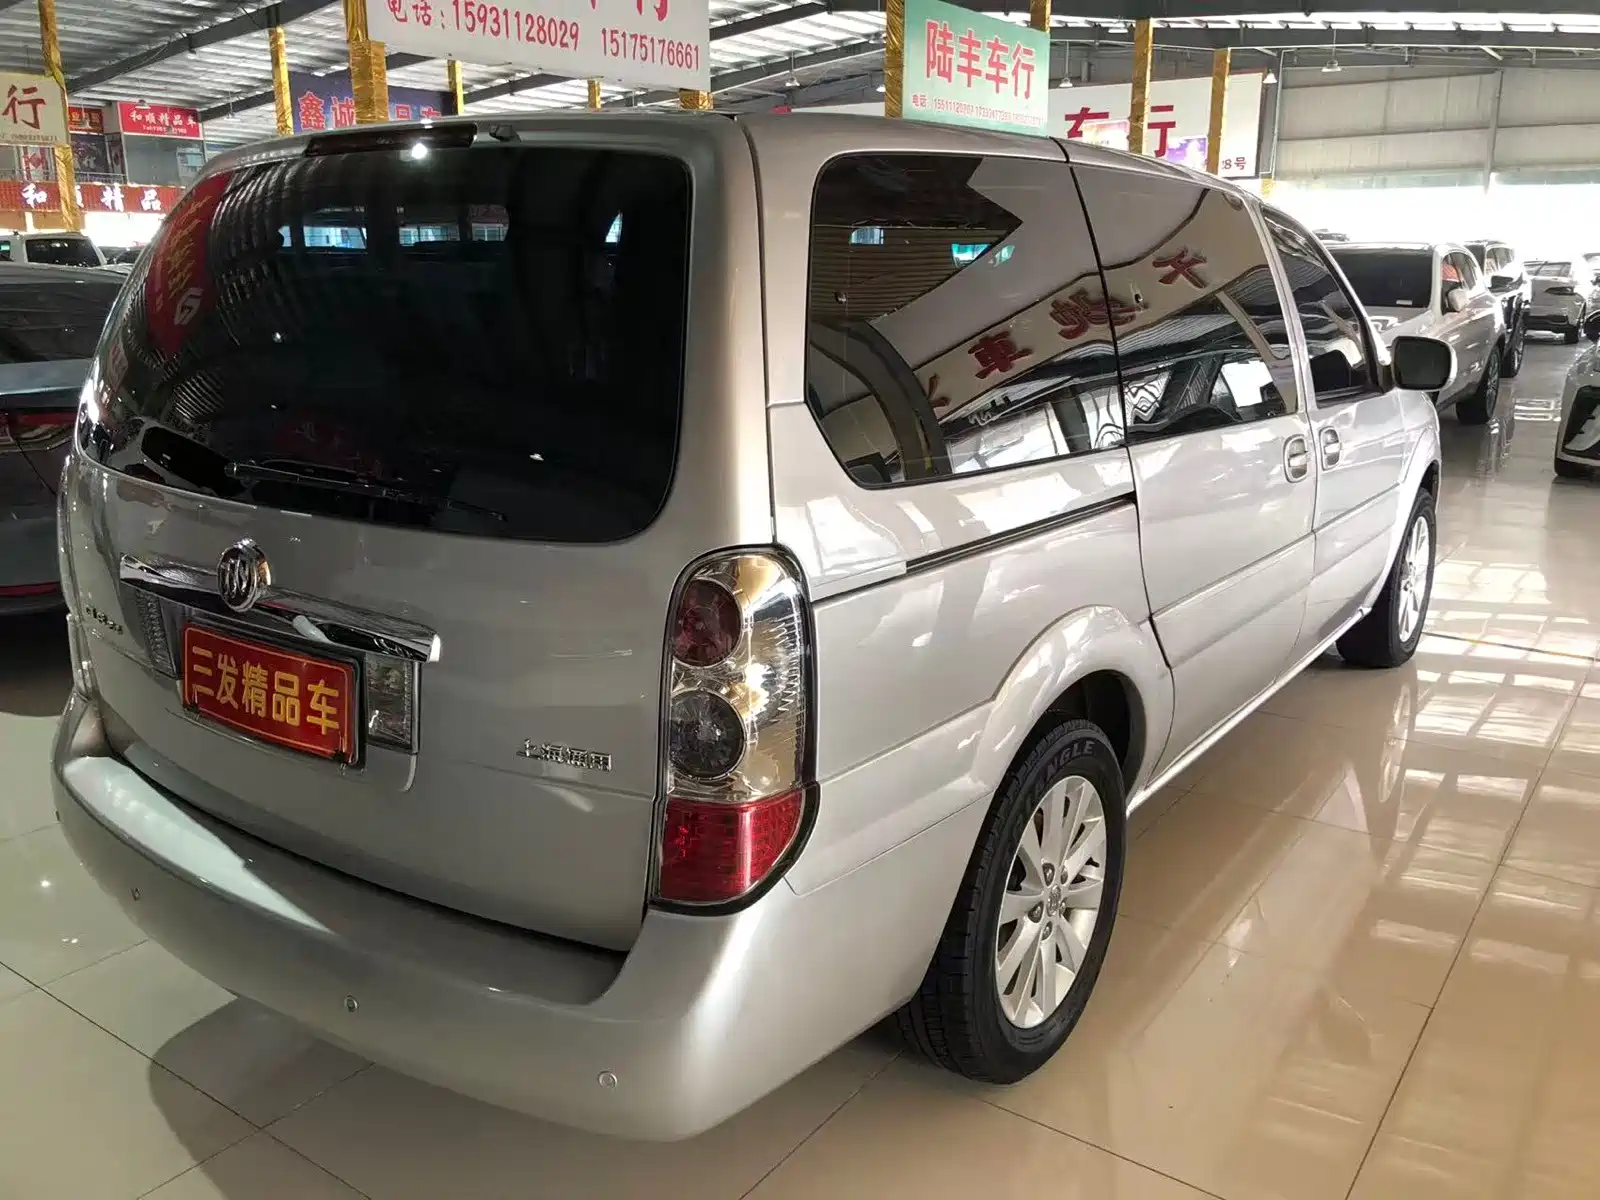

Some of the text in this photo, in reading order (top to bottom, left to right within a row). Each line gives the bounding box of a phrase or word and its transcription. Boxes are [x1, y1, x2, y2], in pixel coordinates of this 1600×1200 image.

[601, 28, 699, 70] 15175176661
[926, 19, 1035, 99] 陆丰车行
[2, 84, 46, 130] 行
[192, 645, 340, 735] 三发精品车
